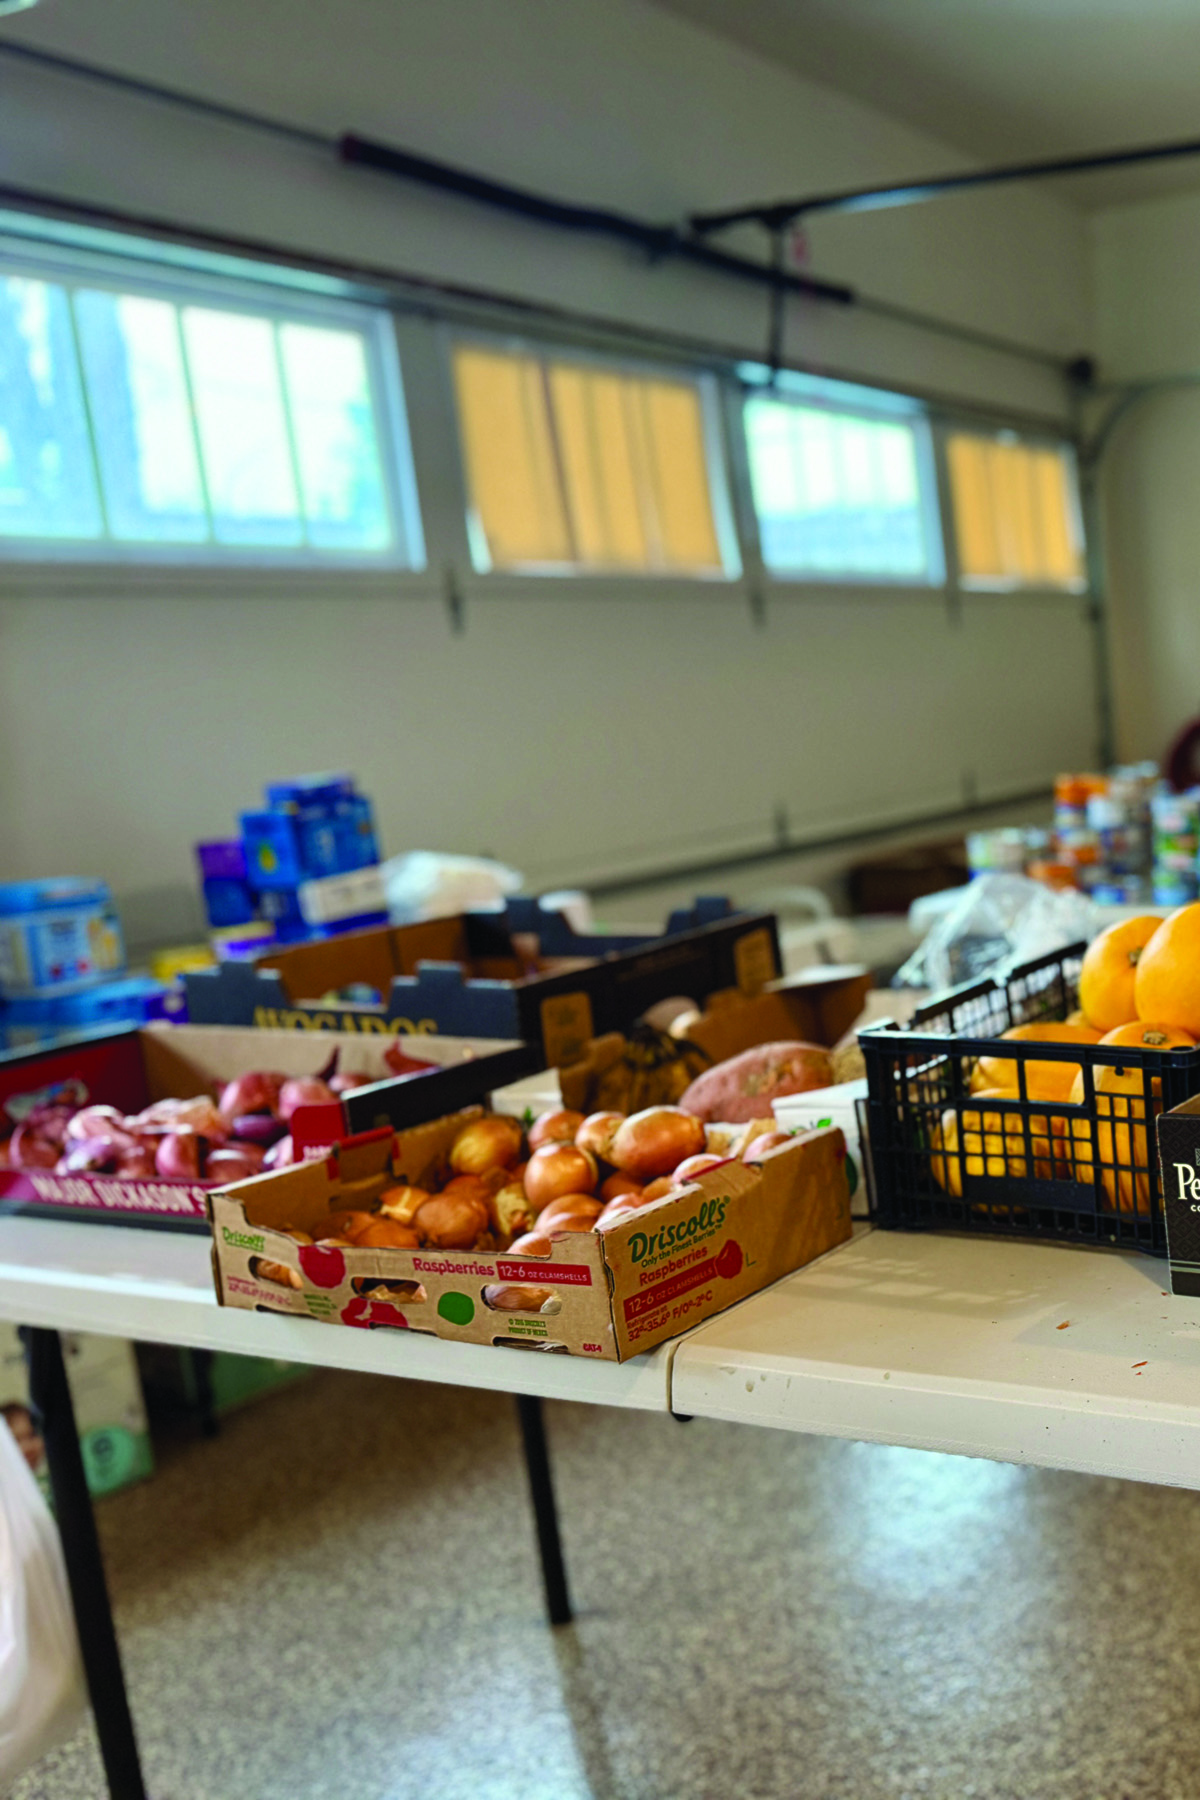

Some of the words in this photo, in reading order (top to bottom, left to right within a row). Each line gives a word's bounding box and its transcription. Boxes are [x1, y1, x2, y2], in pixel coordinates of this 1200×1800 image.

[658, 1249, 671, 1261] the
[671, 1241, 693, 1256] Finest
[412, 1257, 495, 1277] Raspberries
[500, 1265, 525, 1278] 12-6
[538, 1272, 588, 1282] CLAMSHELLS
[639, 1246, 708, 1287] Raspberries
[629, 1292, 654, 1313] 12-6
